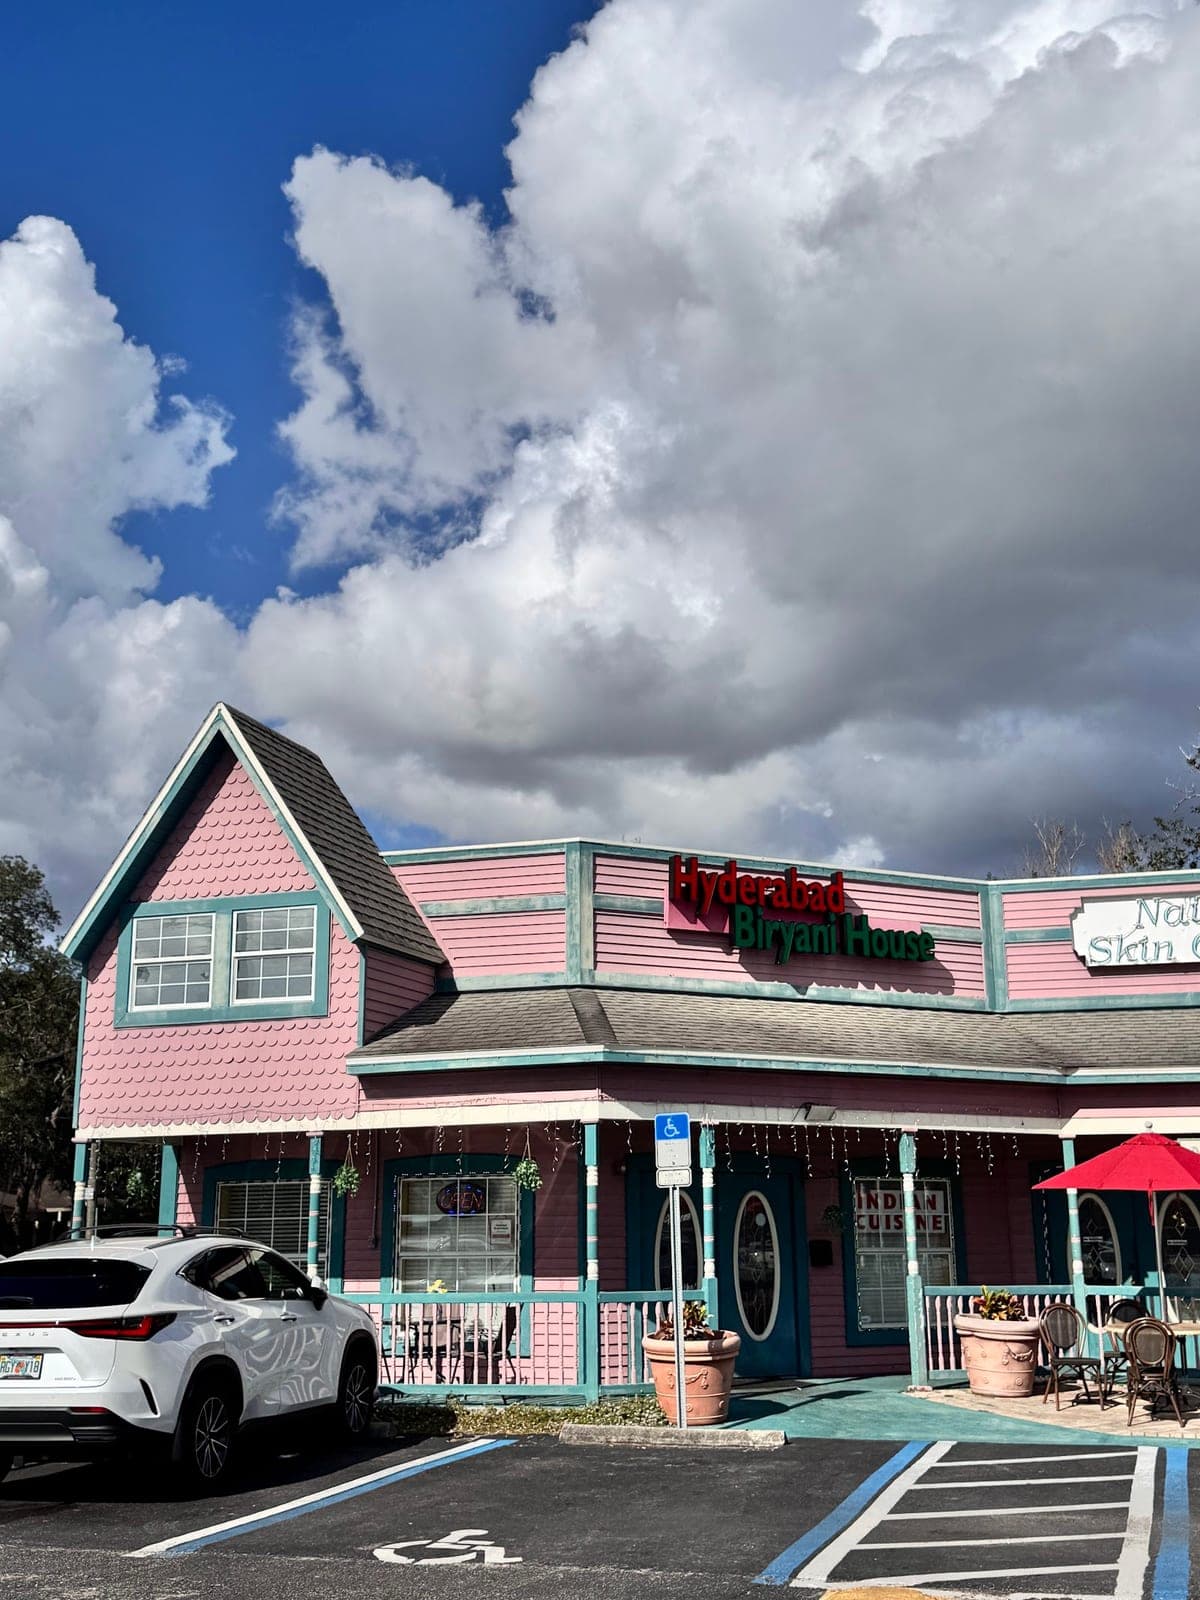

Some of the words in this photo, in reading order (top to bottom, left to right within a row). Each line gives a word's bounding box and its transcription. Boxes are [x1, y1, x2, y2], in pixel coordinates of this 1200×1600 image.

[669, 855, 845, 915] Hyderabad
[731, 903, 837, 966] Biryani
[840, 913, 935, 961] House
[1089, 934, 1176, 963] Skin
[856, 1215, 942, 1230] CUISNE
